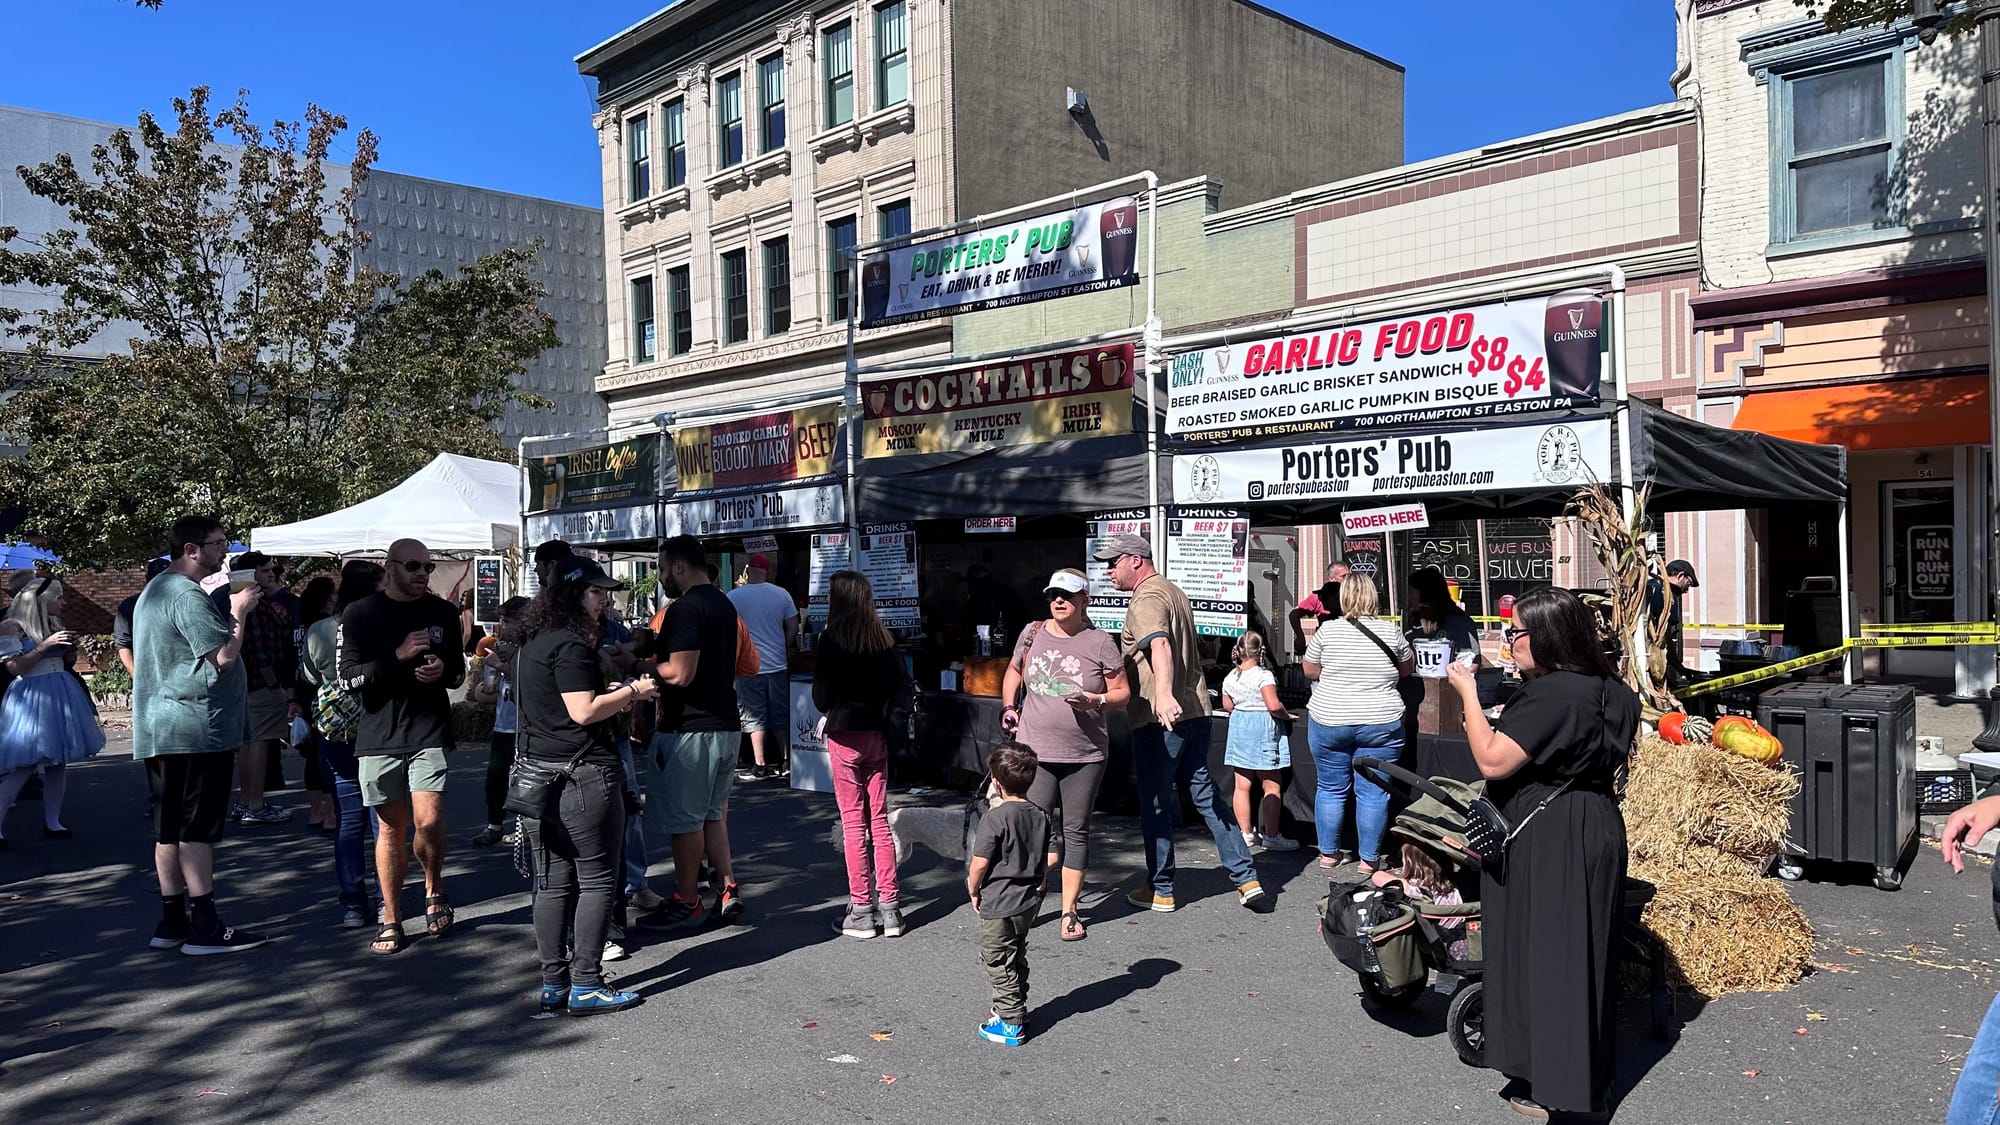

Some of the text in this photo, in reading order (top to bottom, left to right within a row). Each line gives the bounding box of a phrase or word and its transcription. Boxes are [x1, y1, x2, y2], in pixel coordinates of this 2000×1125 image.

[1105, 227, 1133, 239] GUINNESS
[910, 219, 1075, 281] PORTERS' PUB
[921, 259, 1063, 299] EAT, DRINK & BE MERRY!
[1068, 267, 1097, 279] GUINNESS
[872, 316, 904, 327] PORTERS'
[905, 313, 919, 322] PUB
[927, 304, 973, 319] RESTAURANT
[986, 299, 998, 308] 700
[999, 289, 1059, 306] NORTHAMPTON
[1061, 287, 1072, 297] ST
[1073, 281, 1108, 294] EASTON
[1109, 278, 1121, 287] PA
[1553, 329, 1597, 343] GUINNESS
[1244, 312, 1475, 378] GARLIC FOOD
[1172, 352, 1204, 372] CASH
[1171, 335, 1509, 408] BEER BRAISED GARLIC BRISKET SANDWICH $8
[1172, 368, 1204, 388] ONLY!
[1206, 374, 1239, 385] GUINNESS
[894, 354, 1091, 412] COCKTAILS
[1178, 355, 1546, 427] ROASTED SMOKED GARLIC PUMPKIN BISQUE $4
[1062, 401, 1101, 419] IRISH
[954, 412, 1022, 431] KENTUCKY
[1062, 417, 1102, 434] MULE
[1183, 397, 1572, 441] PORTERS' PUB & RESTAURANT 700 NORTHAMPTON ST EASTON PA
[712, 424, 789, 447] SMOKED GARLIC
[878, 422, 927, 438] MOSCOW
[968, 428, 1005, 443] MULE
[886, 437, 915, 450] MULE
[676, 443, 711, 476] WINE
[713, 439, 790, 473] BLOODY MARY
[1282, 435, 1451, 481] Porters' Pub
[1570, 442, 1578, 463] PUB
[567, 445, 637, 481] IRISH Coffee
[1372, 470, 1494, 493] porterspubeaston.com
[1919, 469, 1934, 478] 54
[1267, 478, 1349, 497] porterspubeaston
[715, 493, 783, 521] Porters' Pub
[1178, 508, 1238, 518] DRINKS
[598, 511, 614, 531] Pub
[866, 522, 908, 534] DRINKS
[966, 517, 1014, 529] ORDER HERE
[1107, 522, 1138, 533] BEER $7
[1194, 521, 1229, 533] BEER $7
[1345, 510, 1424, 530] ORDER HERE
[1343, 540, 1381, 553] DIAMONDS
[1488, 542, 1517, 554] WE
[1916, 538, 1950, 550] RUN
[1558, 555, 1571, 564] 50
[1924, 550, 1941, 561] IN
[1916, 561, 1949, 572] RUN
[1916, 573, 1950, 584] OUT
[1190, 601, 1243, 612] LIC FOOD
[1202, 626, 1238, 637] ONLY!
[1902, 636, 1927, 645] CAUTION
[1417, 650, 1442, 668] ite
